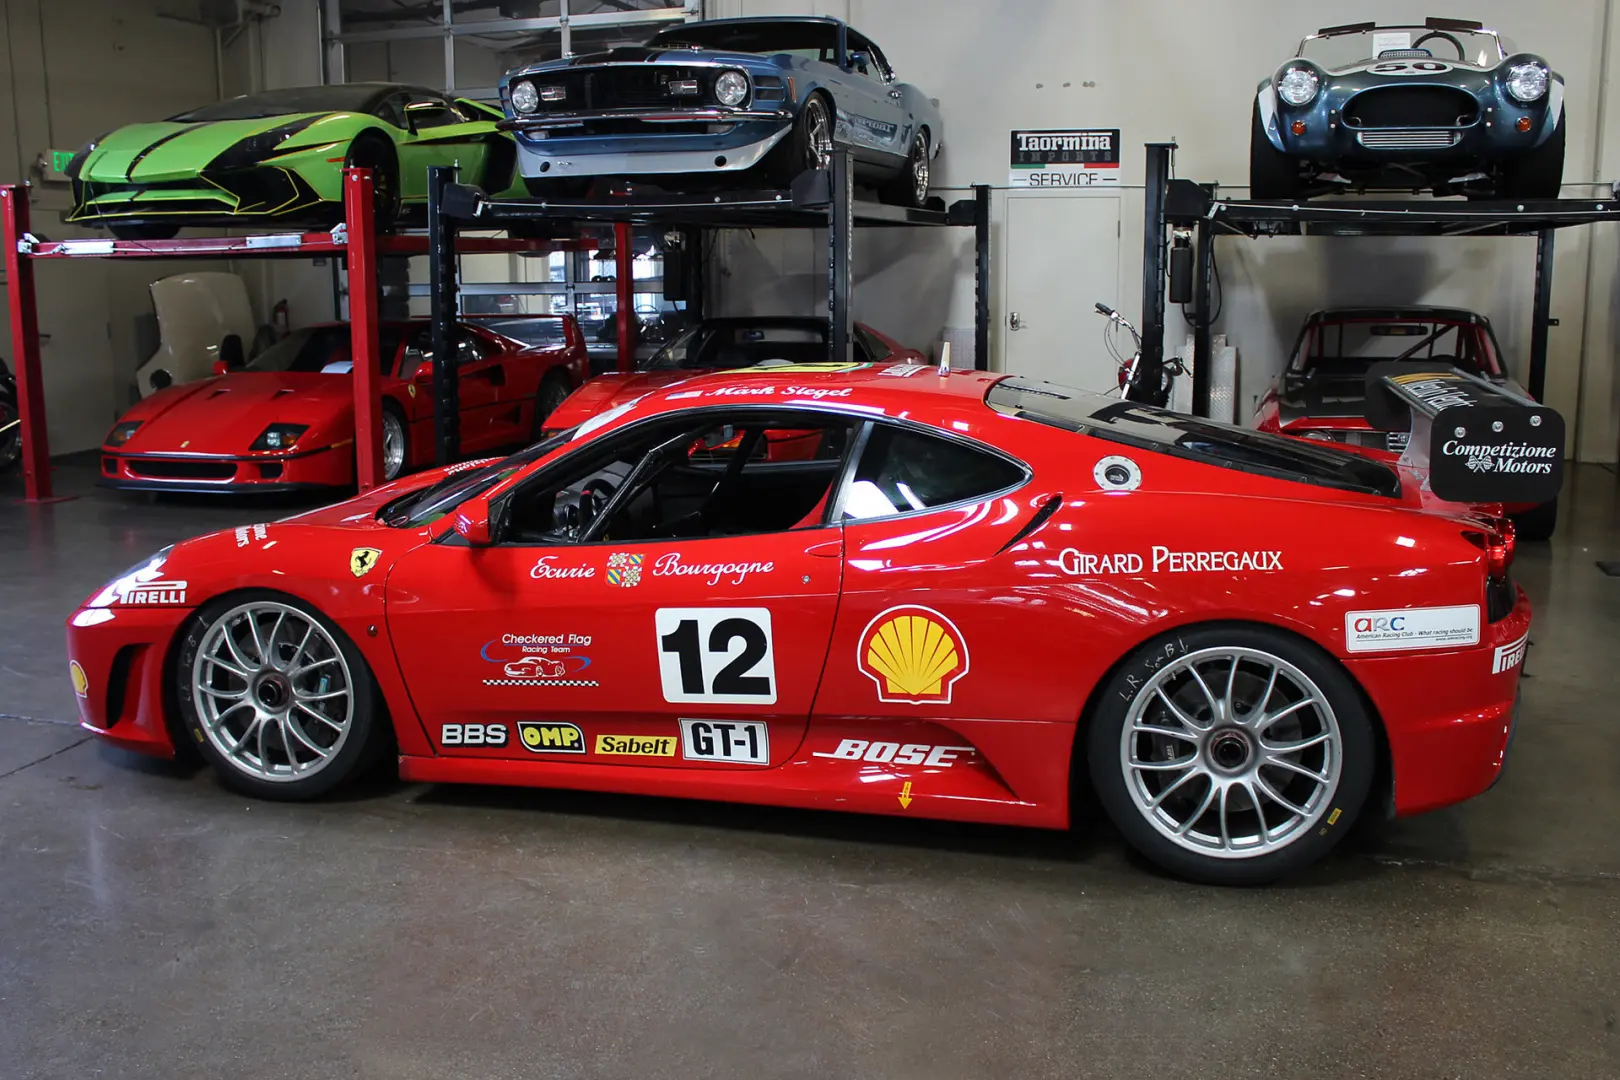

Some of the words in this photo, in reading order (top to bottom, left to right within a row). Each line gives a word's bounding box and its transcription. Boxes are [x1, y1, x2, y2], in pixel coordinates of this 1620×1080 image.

[1374, 61, 1448, 72] 50
[1017, 132, 1112, 151] Taormina
[1018, 151, 1112, 162] IMPORTS
[1029, 172, 1099, 186] SERVICE
[705, 386, 775, 397] Mark
[1442, 440, 1556, 459] Competizione
[1493, 457, 1552, 474] Motors
[530, 555, 596, 579] Ecurie
[652, 552, 774, 586] Bourgogne
[1151, 546, 1284, 573] PERREGAUX
[119, 580, 188, 605] PIRELLI
[502, 633, 565, 645] Checkered
[568, 633, 592, 647] Flag
[1356, 632, 1382, 640] American
[1382, 631, 1401, 639] Racing
[1418, 629, 1433, 637] What
[521, 645, 549, 655] Racing
[550, 645, 571, 654] Team
[661, 617, 771, 696] 12
[1492, 631, 1528, 675] PIRE
[441, 722, 508, 745] BBS
[522, 726, 579, 747] OMP
[690, 722, 760, 759] GT-1
[601, 736, 671, 755] Sabelt
[812, 739, 976, 768] BOSE
